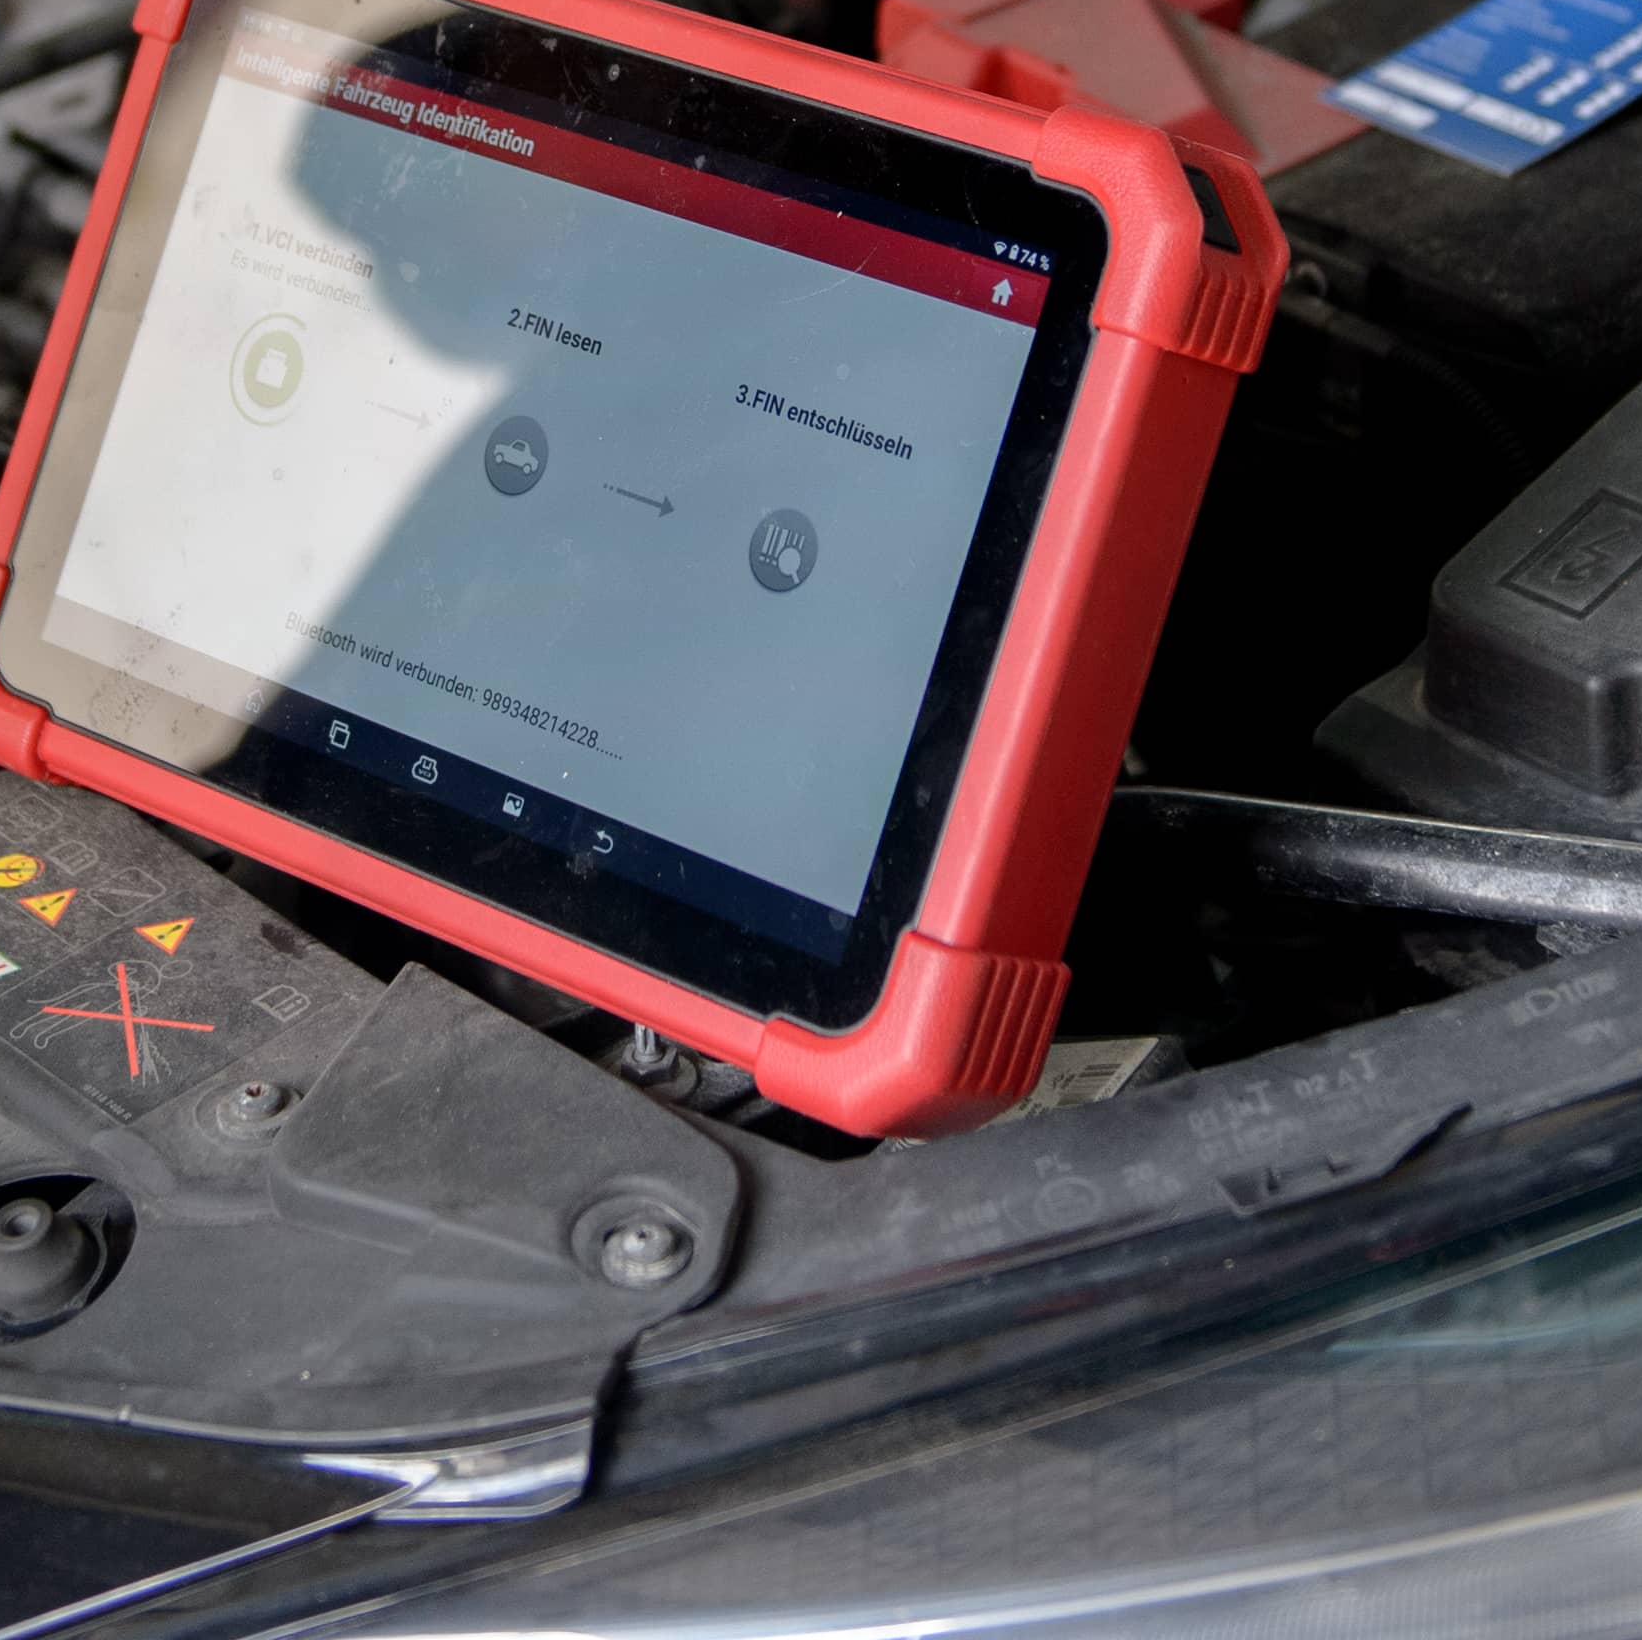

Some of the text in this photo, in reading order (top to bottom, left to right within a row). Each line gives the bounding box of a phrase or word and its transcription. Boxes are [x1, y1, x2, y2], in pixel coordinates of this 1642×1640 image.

[236, 45, 536, 156] Intelligente Fahrzeug Identifikation
[253, 258, 284, 280] wird
[296, 239, 373, 279] verbinden
[507, 308, 602, 356] 2.FIN lesen
[735, 384, 913, 460] 3.FIN entschlüsseln
[285, 611, 357, 655] Bluetooth
[359, 643, 394, 668] wird
[396, 658, 479, 702] verbunden:
